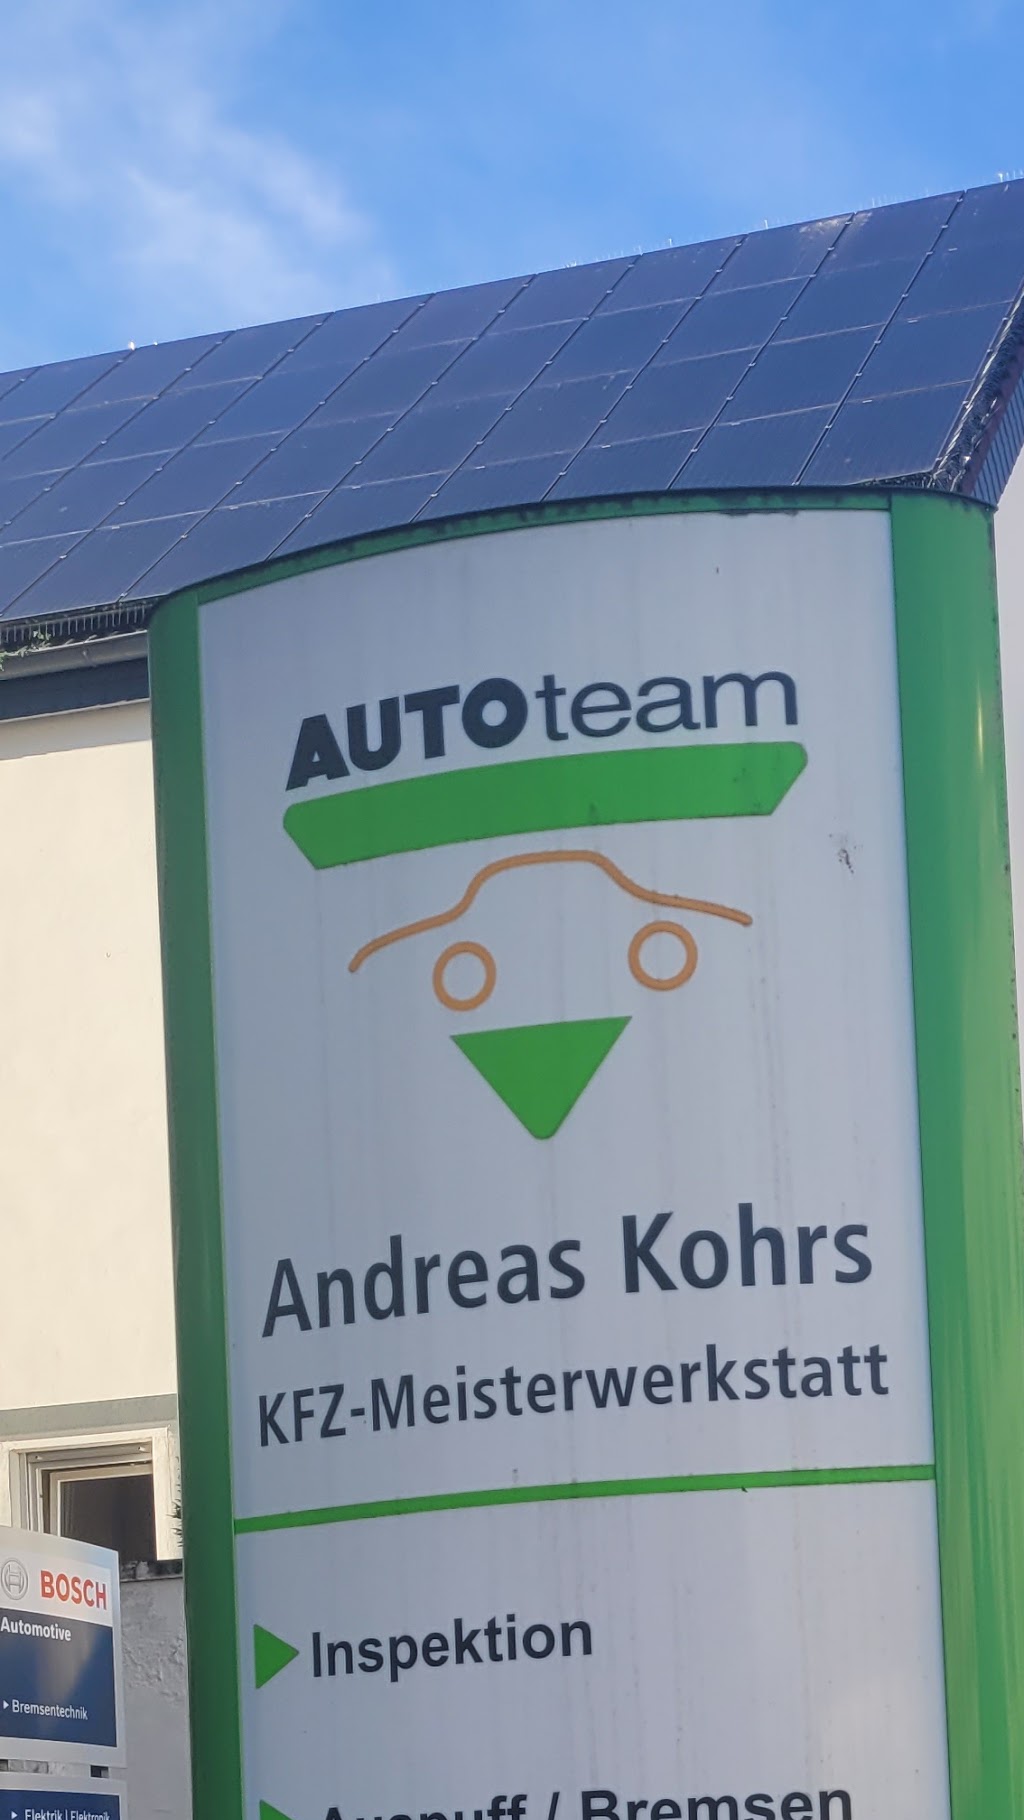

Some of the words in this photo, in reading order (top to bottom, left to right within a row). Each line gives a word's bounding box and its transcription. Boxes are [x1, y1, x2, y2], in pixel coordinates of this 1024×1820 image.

[285, 671, 798, 792] AUTOteam
[262, 1235, 586, 1338] Andreas
[622, 1202, 872, 1293] Kohrs
[258, 1344, 889, 1447] KFZ-Meisterwerkstatt
[40, 1570, 107, 1610] BOSCH
[0, 1616, 72, 1642] Automotive
[311, 1613, 593, 1682] Inspektion
[12, 1700, 88, 1720] Bremsentechnik
